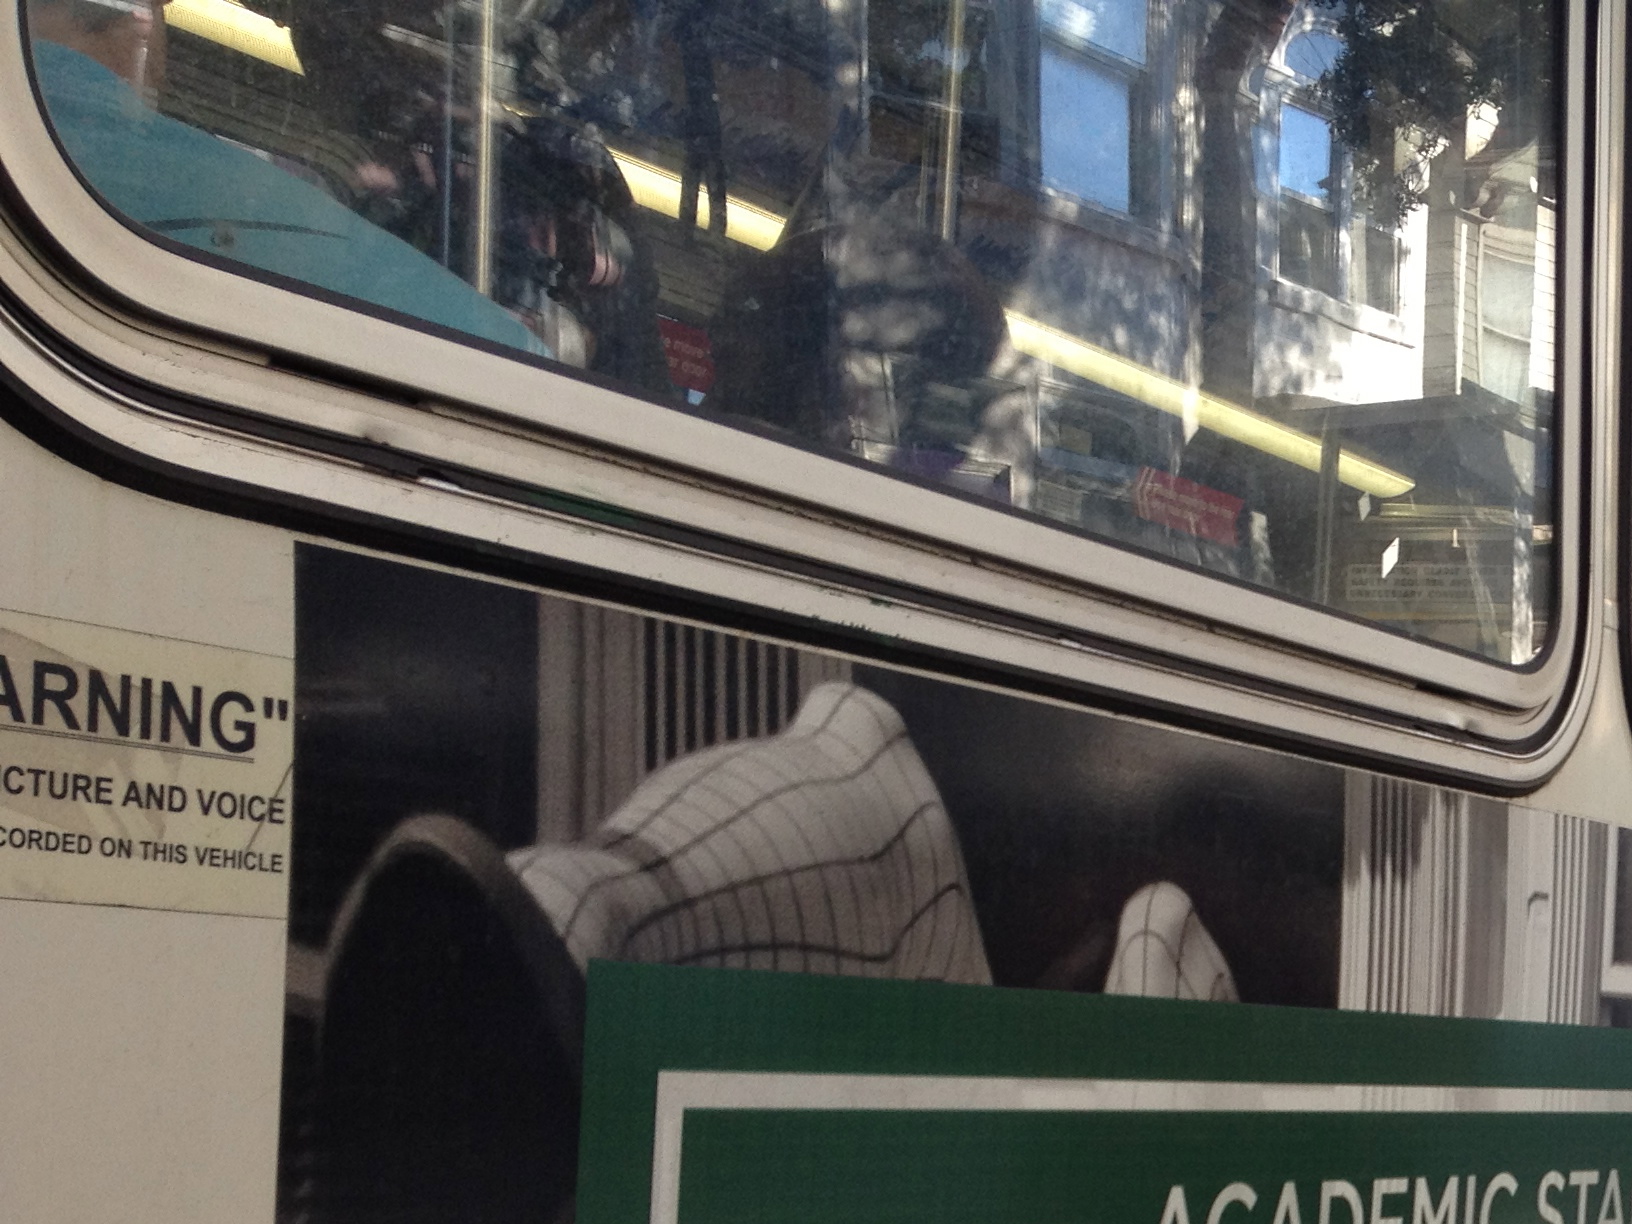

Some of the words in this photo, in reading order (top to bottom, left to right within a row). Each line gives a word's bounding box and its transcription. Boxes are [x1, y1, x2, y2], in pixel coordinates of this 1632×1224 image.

[121, 780, 189, 814] AND
[196, 788, 286, 825] VOICE
[99, 836, 133, 859] ON
[139, 840, 188, 865] THIS
[194, 846, 284, 874] VEHICLE
